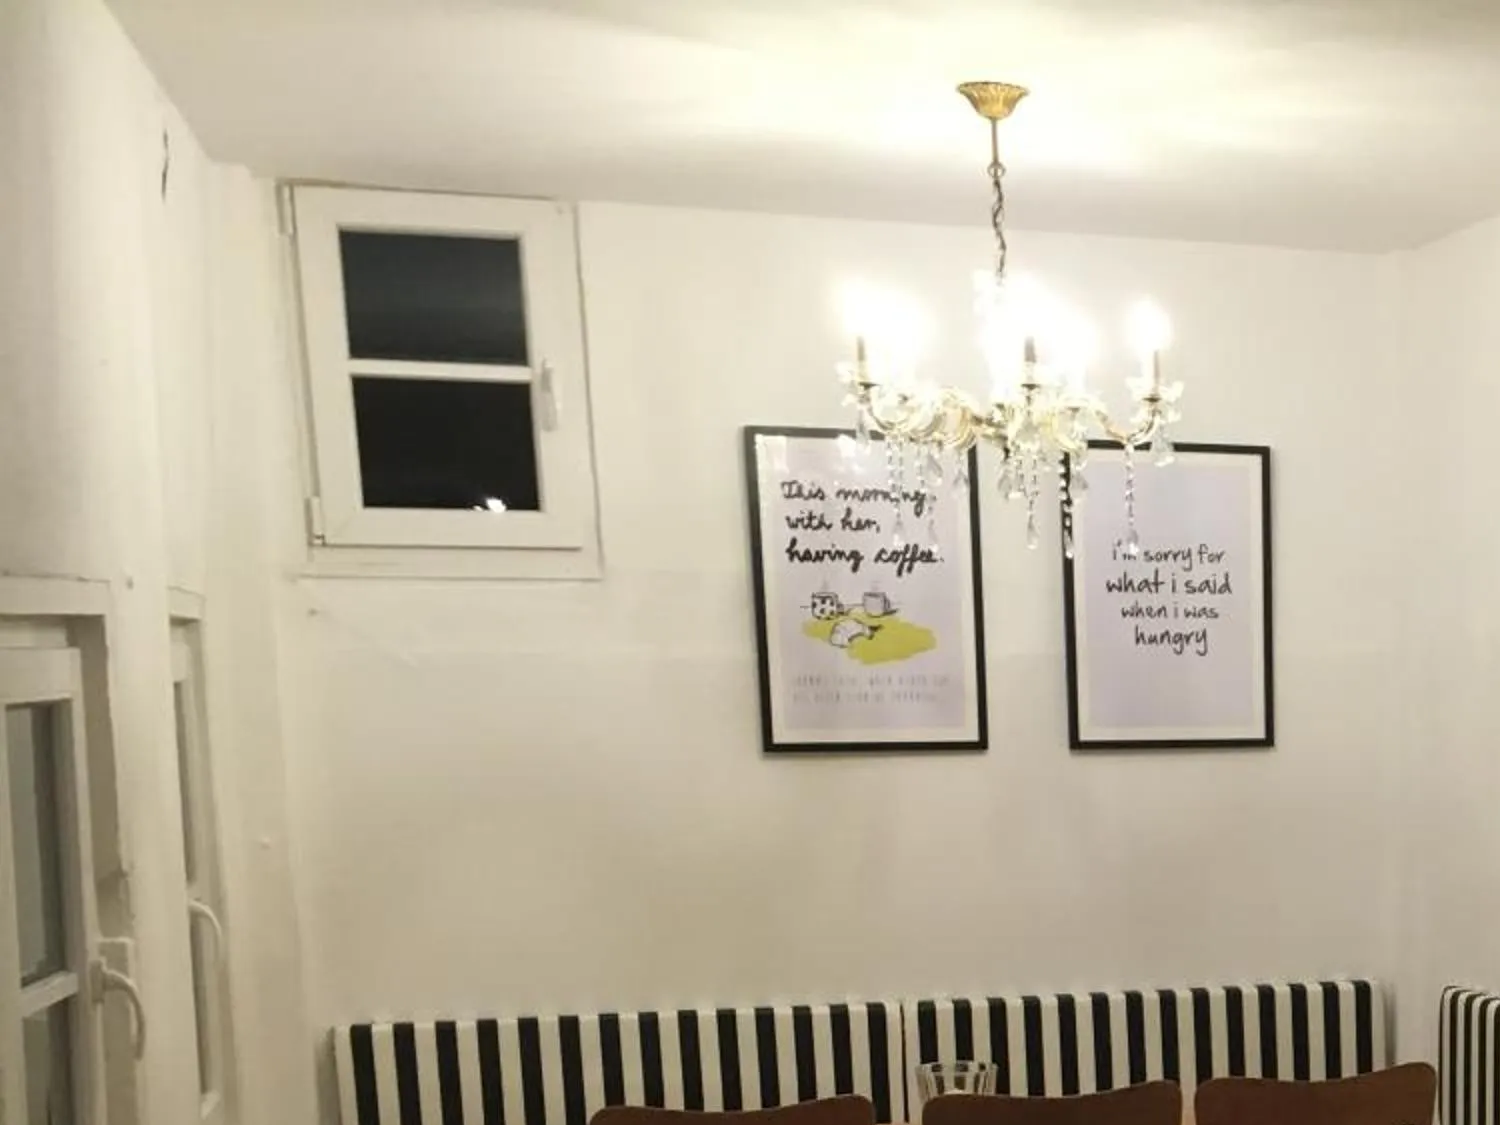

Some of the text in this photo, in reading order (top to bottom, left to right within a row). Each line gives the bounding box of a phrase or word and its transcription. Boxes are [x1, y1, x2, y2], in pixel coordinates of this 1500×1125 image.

[781, 480, 825, 501] This
[785, 510, 833, 531] with
[785, 537, 865, 574] having
[1143, 547, 1193, 572] sorry
[1197, 543, 1226, 564] for
[1105, 568, 1233, 595] what i said
[1121, 600, 1220, 619] when i was
[1135, 624, 1209, 657] hungry
